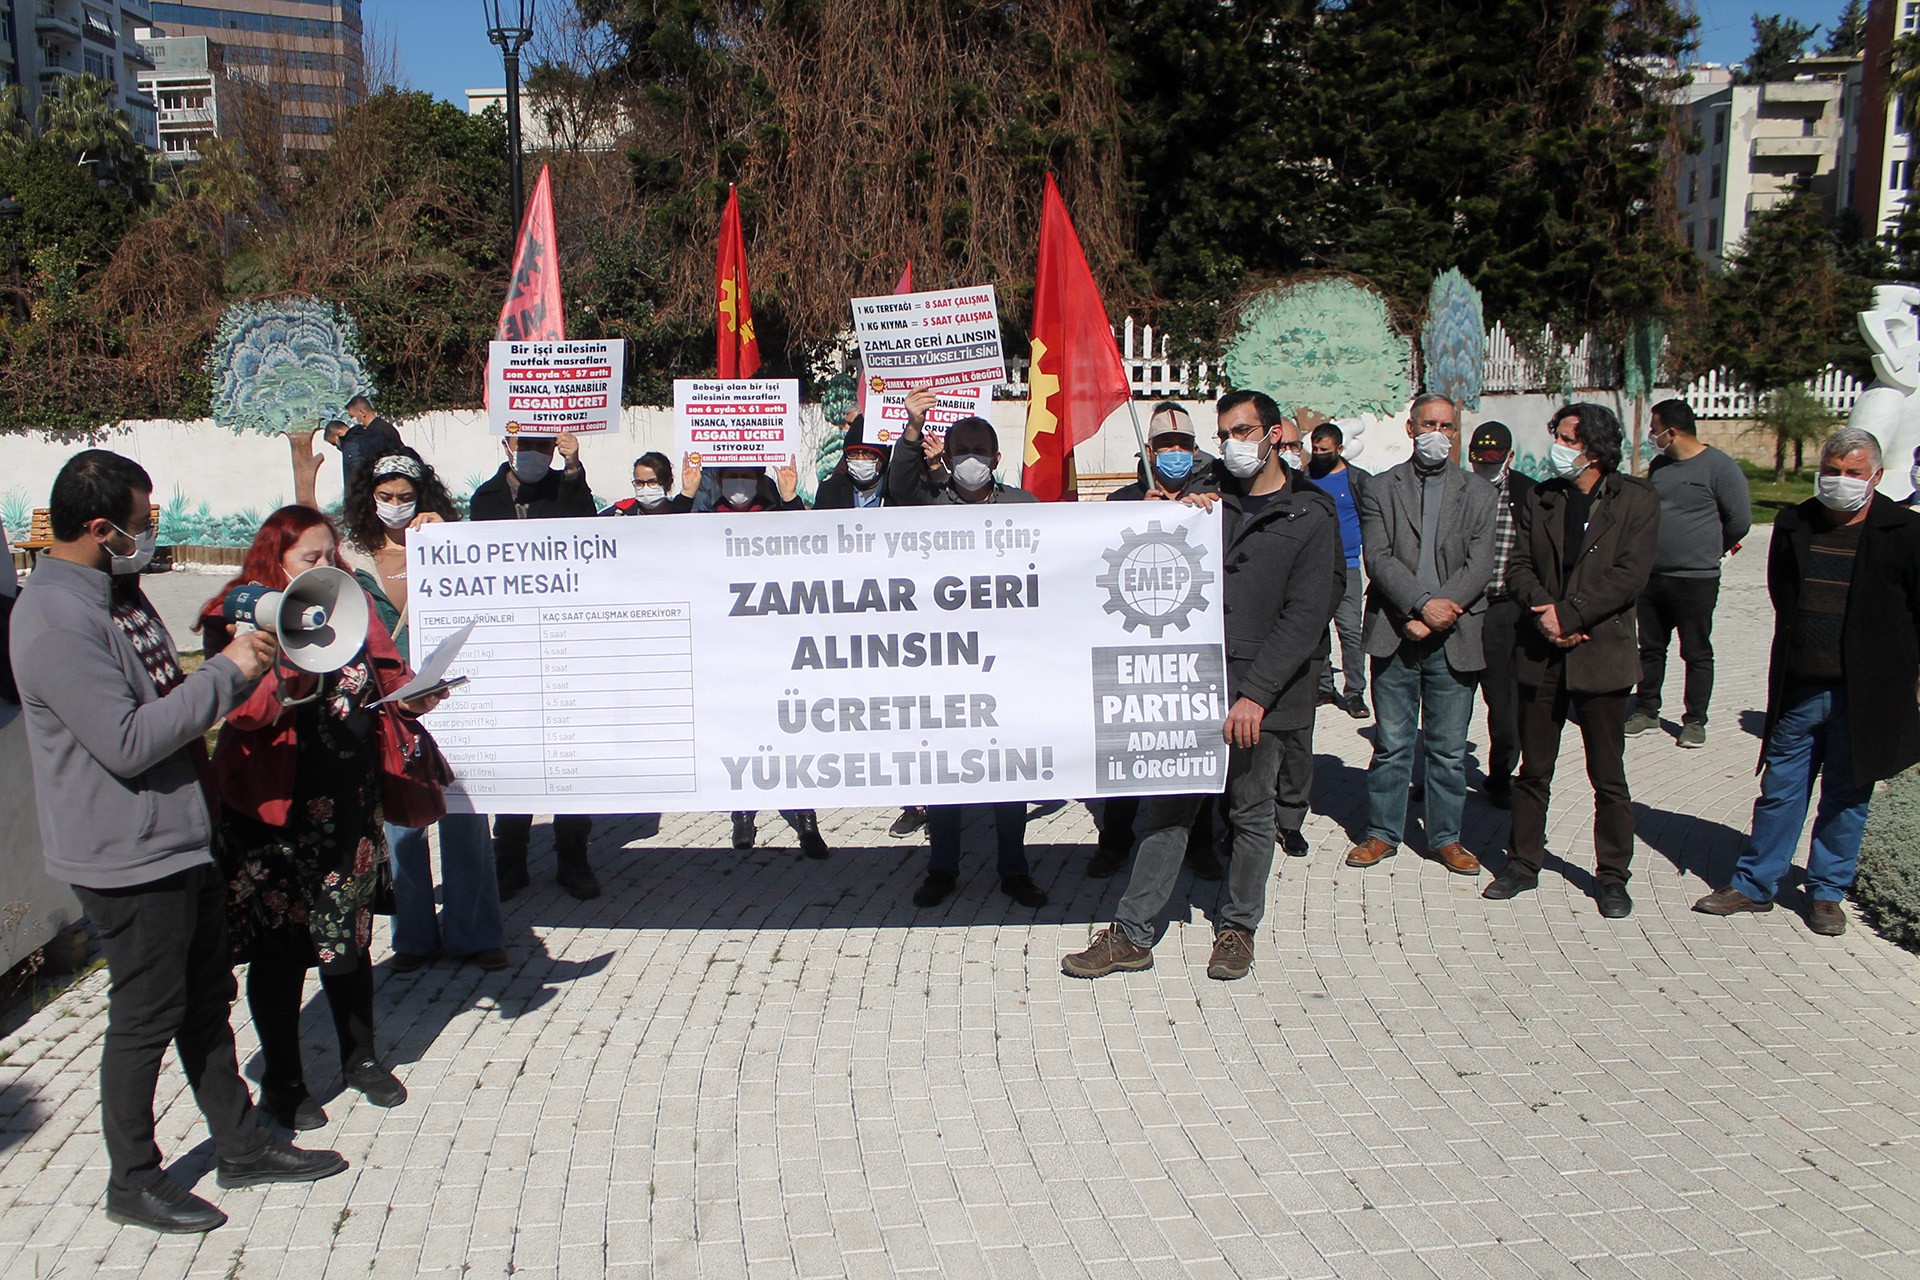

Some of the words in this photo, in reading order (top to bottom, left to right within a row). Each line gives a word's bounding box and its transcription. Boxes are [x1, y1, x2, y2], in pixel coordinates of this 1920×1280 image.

[857, 306, 861, 314] 1
[864, 306, 874, 314] KG
[876, 301, 912, 313] TEREYAĞI
[925, 301, 930, 309] 8
[933, 299, 952, 309] SAAT
[955, 295, 989, 308] ÇALIŞMA
[860, 322, 864, 331] 1
[867, 322, 879, 331] KG
[881, 320, 908, 330] KIYMA
[923, 318, 929, 327] 5
[931, 315, 952, 326] SAAT
[955, 311, 993, 325] ÇALIŞMA
[864, 338, 912, 351] ZAMLAR
[914, 333, 943, 349] GERİ
[946, 329, 996, 345] ALINSIN
[511, 344, 529, 354] Bir
[533, 344, 552, 356] işçi
[557, 342, 607, 354] ailesinin
[868, 351, 918, 367] ÜCRETLER
[919, 345, 997, 365] YÜKSELTİLSİN!
[510, 357, 550, 366] mutfak
[554, 355, 607, 365] masrafları
[506, 371, 523, 379] son
[526, 370, 533, 379] 6
[536, 370, 560, 380] ayda
[562, 370, 570, 378] %
[575, 369, 588, 378] 57
[590, 368, 608, 377] arttı
[887, 380, 905, 389] EMEK
[906, 377, 933, 389] PARTİSİ
[935, 375, 960, 386] ADANA
[962, 373, 970, 382] İL
[971, 368, 1002, 381] ÖRGÜTÜ
[509, 382, 551, 395] İNSANCA,
[554, 380, 608, 397] YAŞANABİLİR
[693, 383, 724, 392] Bebeği
[765, 383, 779, 392] işçi
[513, 396, 564, 409] ASGARİ
[568, 395, 604, 408] ÜCRET
[533, 411, 588, 421] İSTİYORUZ!
[705, 405, 712, 413] 6
[714, 405, 736, 415] ayda
[738, 405, 746, 413] %
[749, 405, 760, 413] 61
[691, 416, 728, 428] İNSANCA,
[730, 415, 784, 429] YAŞANABİLİR
[694, 428, 741, 440] ASGARİ
[744, 428, 781, 440] ÜCRET
[713, 443, 764, 451] İSTİYORUZ!
[725, 528, 828, 558] insanca
[837, 523, 876, 554] bir
[884, 529, 975, 559] yaşam
[984, 519, 1041, 558] için;
[417, 546, 425, 565] 1
[431, 539, 481, 565] KİLO
[487, 535, 568, 563] PEYNİR
[573, 534, 617, 565] İÇİN
[419, 578, 432, 597] 4
[439, 576, 496, 597] SAAT
[503, 567, 579, 595] MESAİ!
[1124, 566, 1190, 592] EMEP
[728, 577, 918, 617] ZAMLAR
[933, 562, 1039, 611] GERİ
[423, 617, 450, 625] TEMEL
[452, 617, 471, 625] GIDA
[543, 613, 560, 622] KAÇ
[562, 612, 583, 620] SAAT
[585, 610, 629, 621] ÇALIŞMAK
[630, 607, 682, 619] GEREKİYOR?
[550, 630, 566, 638] saat
[455, 650, 473, 659] eynir
[544, 647, 549, 655] 4
[551, 647, 567, 655] saat
[791, 631, 996, 673] ALINSIN,
[551, 664, 568, 672] saat
[1117, 653, 1200, 685] EMEK
[545, 681, 550, 689] 4
[552, 681, 569, 689] saat
[437, 702, 451, 710] cuk
[559, 698, 576, 706] saat
[1102, 684, 1220, 724] PARTİSİ
[777, 688, 999, 734] ÜCRETLER
[552, 715, 569, 724] saat
[559, 732, 576, 741] saat
[1127, 730, 1198, 752] ADANA
[559, 749, 576, 758] saat
[561, 766, 578, 775] saat
[721, 737, 1054, 791] YÜKSELTİLSİN!
[1108, 755, 1126, 781] İL
[1132, 750, 1217, 780] ÖRGÜTÜ
[556, 783, 573, 792] saat
